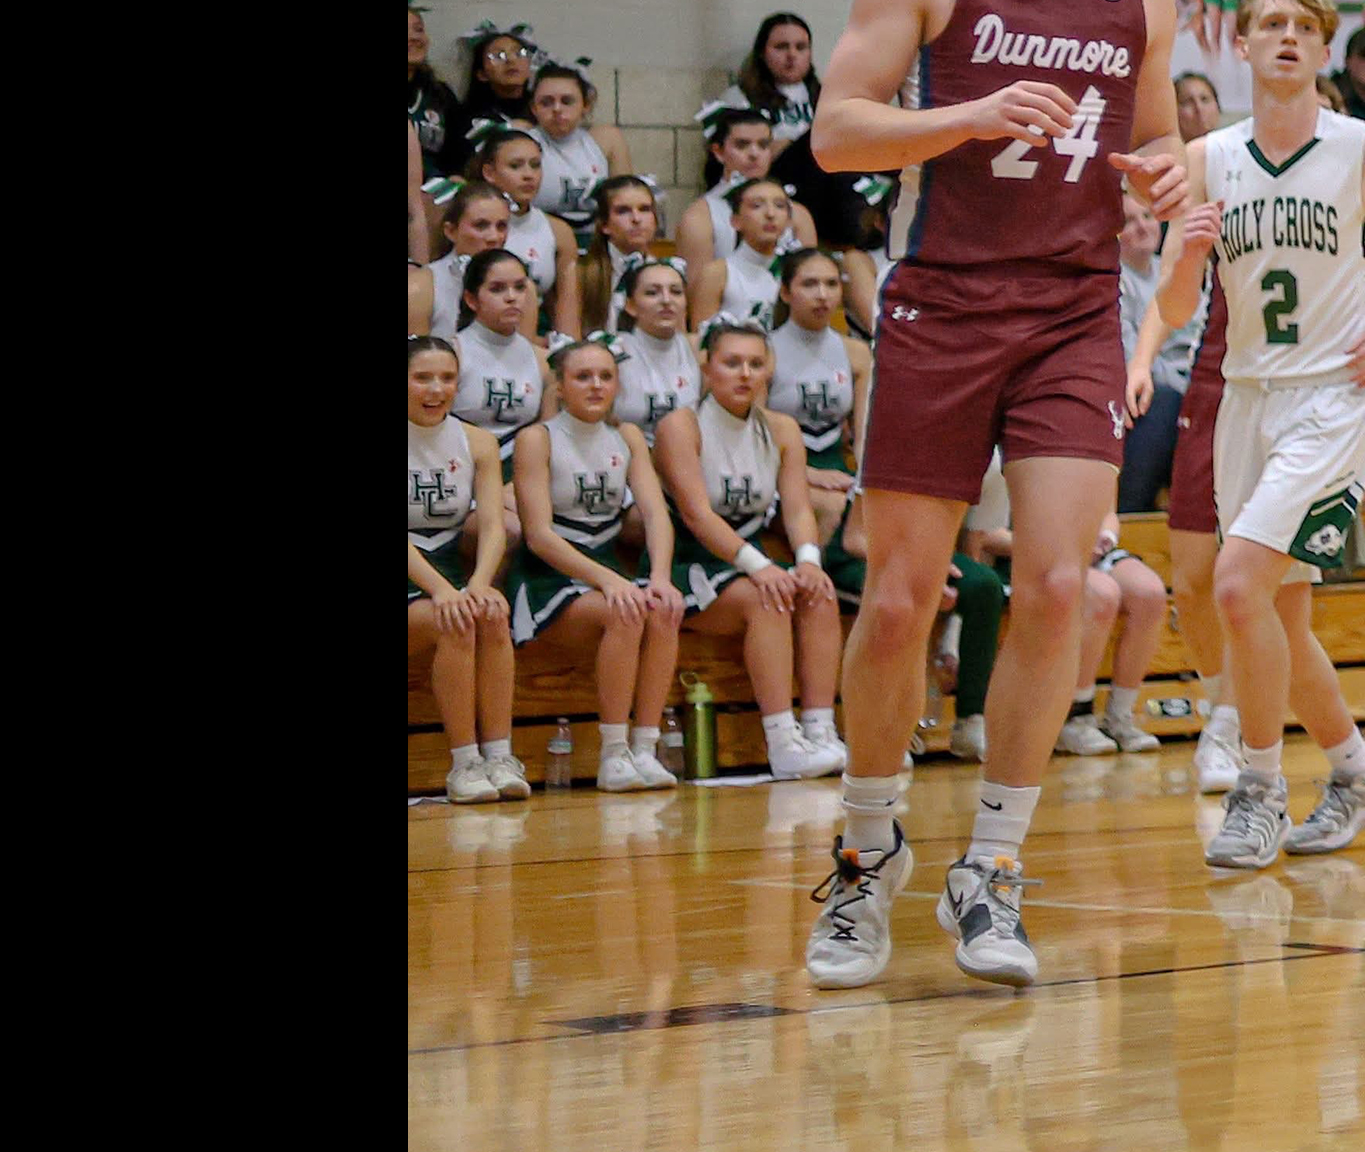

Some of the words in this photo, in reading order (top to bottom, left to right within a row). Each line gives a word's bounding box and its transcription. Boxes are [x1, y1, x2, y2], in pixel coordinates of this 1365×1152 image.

[970, 13, 1132, 78] Dunmore
[991, 84, 1107, 183] 24
[1220, 198, 1266, 264] HOLY
[1273, 196, 1339, 257] CROSS
[1261, 269, 1299, 344] 2
